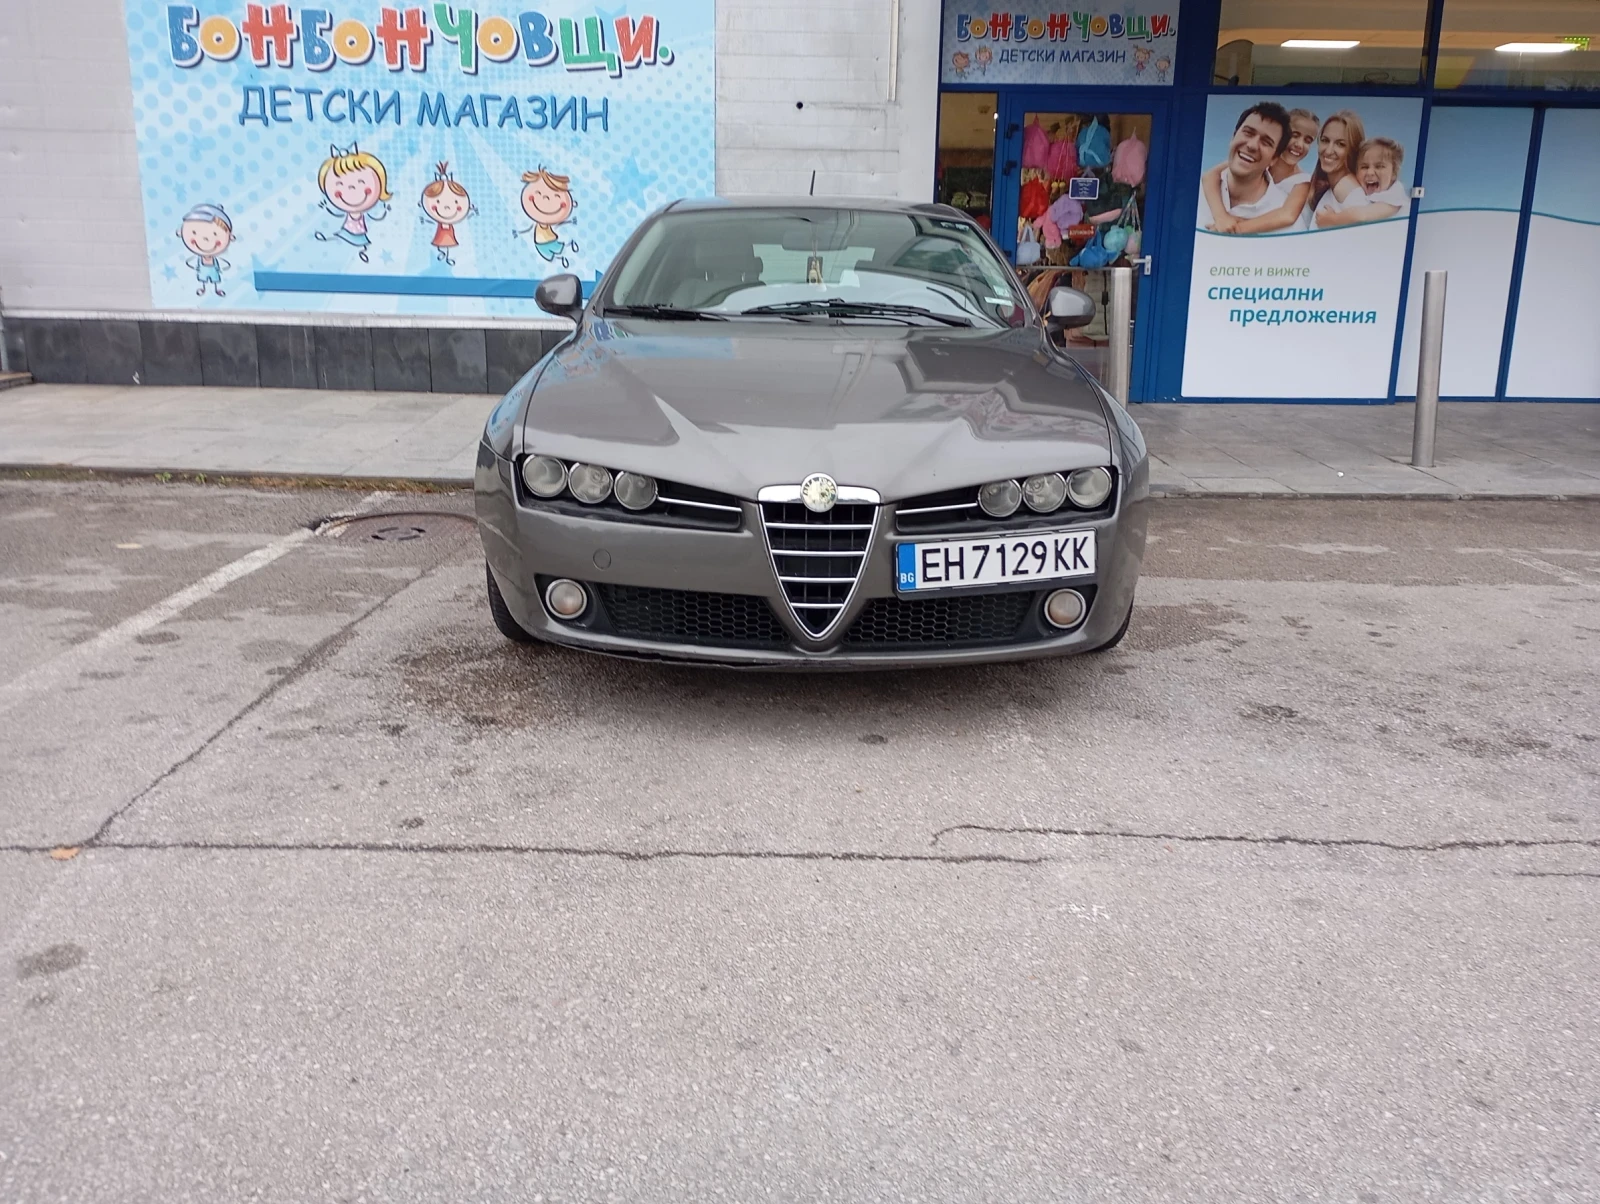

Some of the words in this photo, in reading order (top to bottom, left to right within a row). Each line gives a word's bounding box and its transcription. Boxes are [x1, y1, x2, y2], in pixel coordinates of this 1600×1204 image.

[1000, 49, 1055, 63] ДЕТСКИ
[1059, 49, 1126, 63] МАГАЗИН
[239, 85, 401, 127] ДЕТСКИ
[416, 91, 609, 132] МАГАЗИН
[1209, 266, 1251, 276] елате
[1254, 266, 1263, 276] и
[1267, 267, 1311, 277] вижте
[1207, 286, 1324, 303] специални
[1229, 308, 1377, 327] предложения
[900, 572, 915, 583] BG
